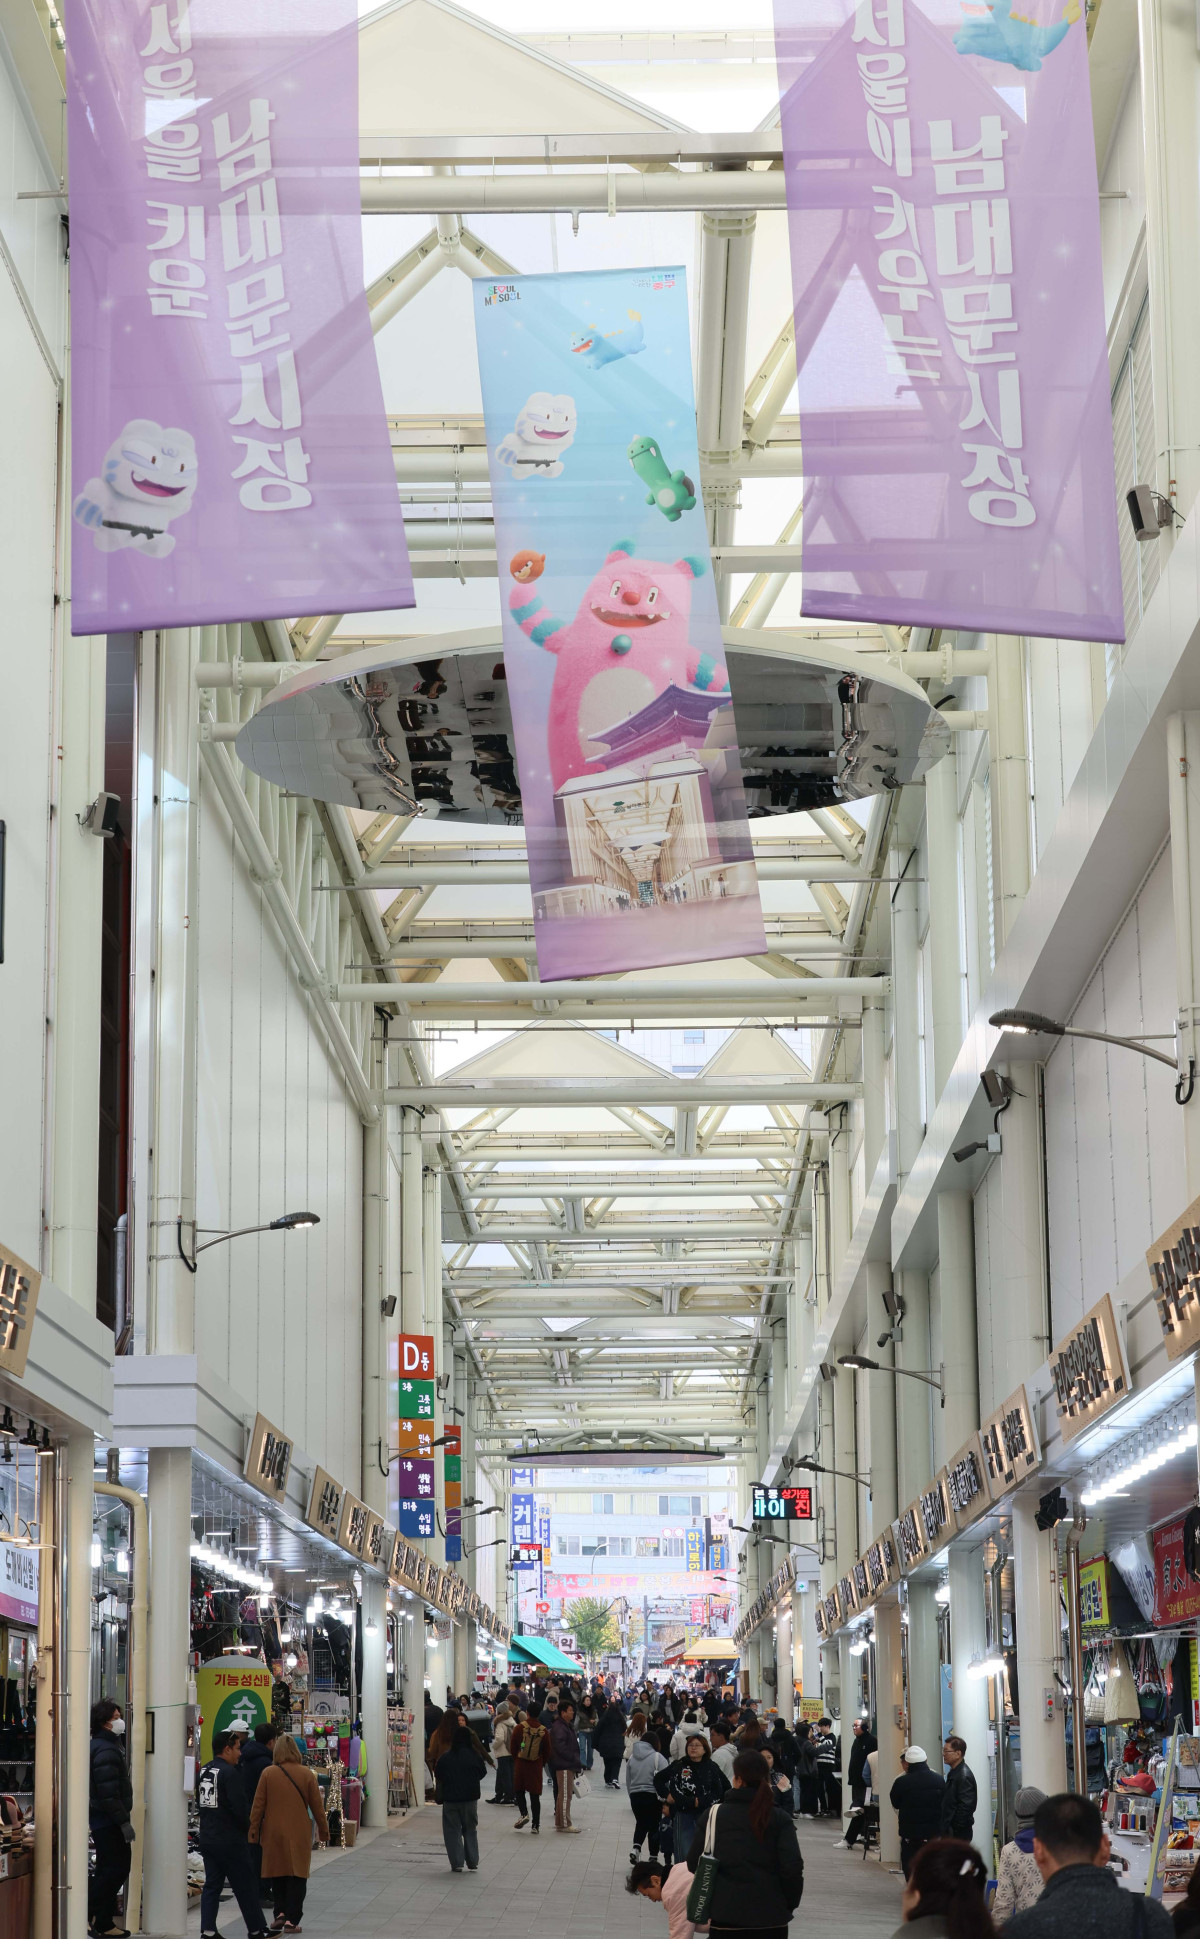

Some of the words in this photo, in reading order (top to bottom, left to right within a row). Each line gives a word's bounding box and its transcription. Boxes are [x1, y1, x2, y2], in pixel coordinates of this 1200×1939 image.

[139, 0, 202, 182] 서울을
[851, 0, 913, 177] 서울이
[146, 200, 209, 319] 키운
[872, 185, 942, 381] 키우는
[211, 98, 313, 512] 남대문시장
[926, 115, 1037, 529] 남대문시장
[403, 1341, 430, 1371] D동
[402, 1382, 413, 1392] 3층
[418, 1395, 430, 1404] 그릇
[418, 1406, 431, 1415] 도매
[402, 1421, 413, 1432] 2층
[418, 1473, 431, 1483] 생활
[418, 1485, 431, 1494] 잡화
[418, 1514, 431, 1523] 수입
[418, 1525, 431, 1534] 명품
[214, 1673, 270, 1687] 기능성신발
[703, 1864, 712, 1894] DAUNT
